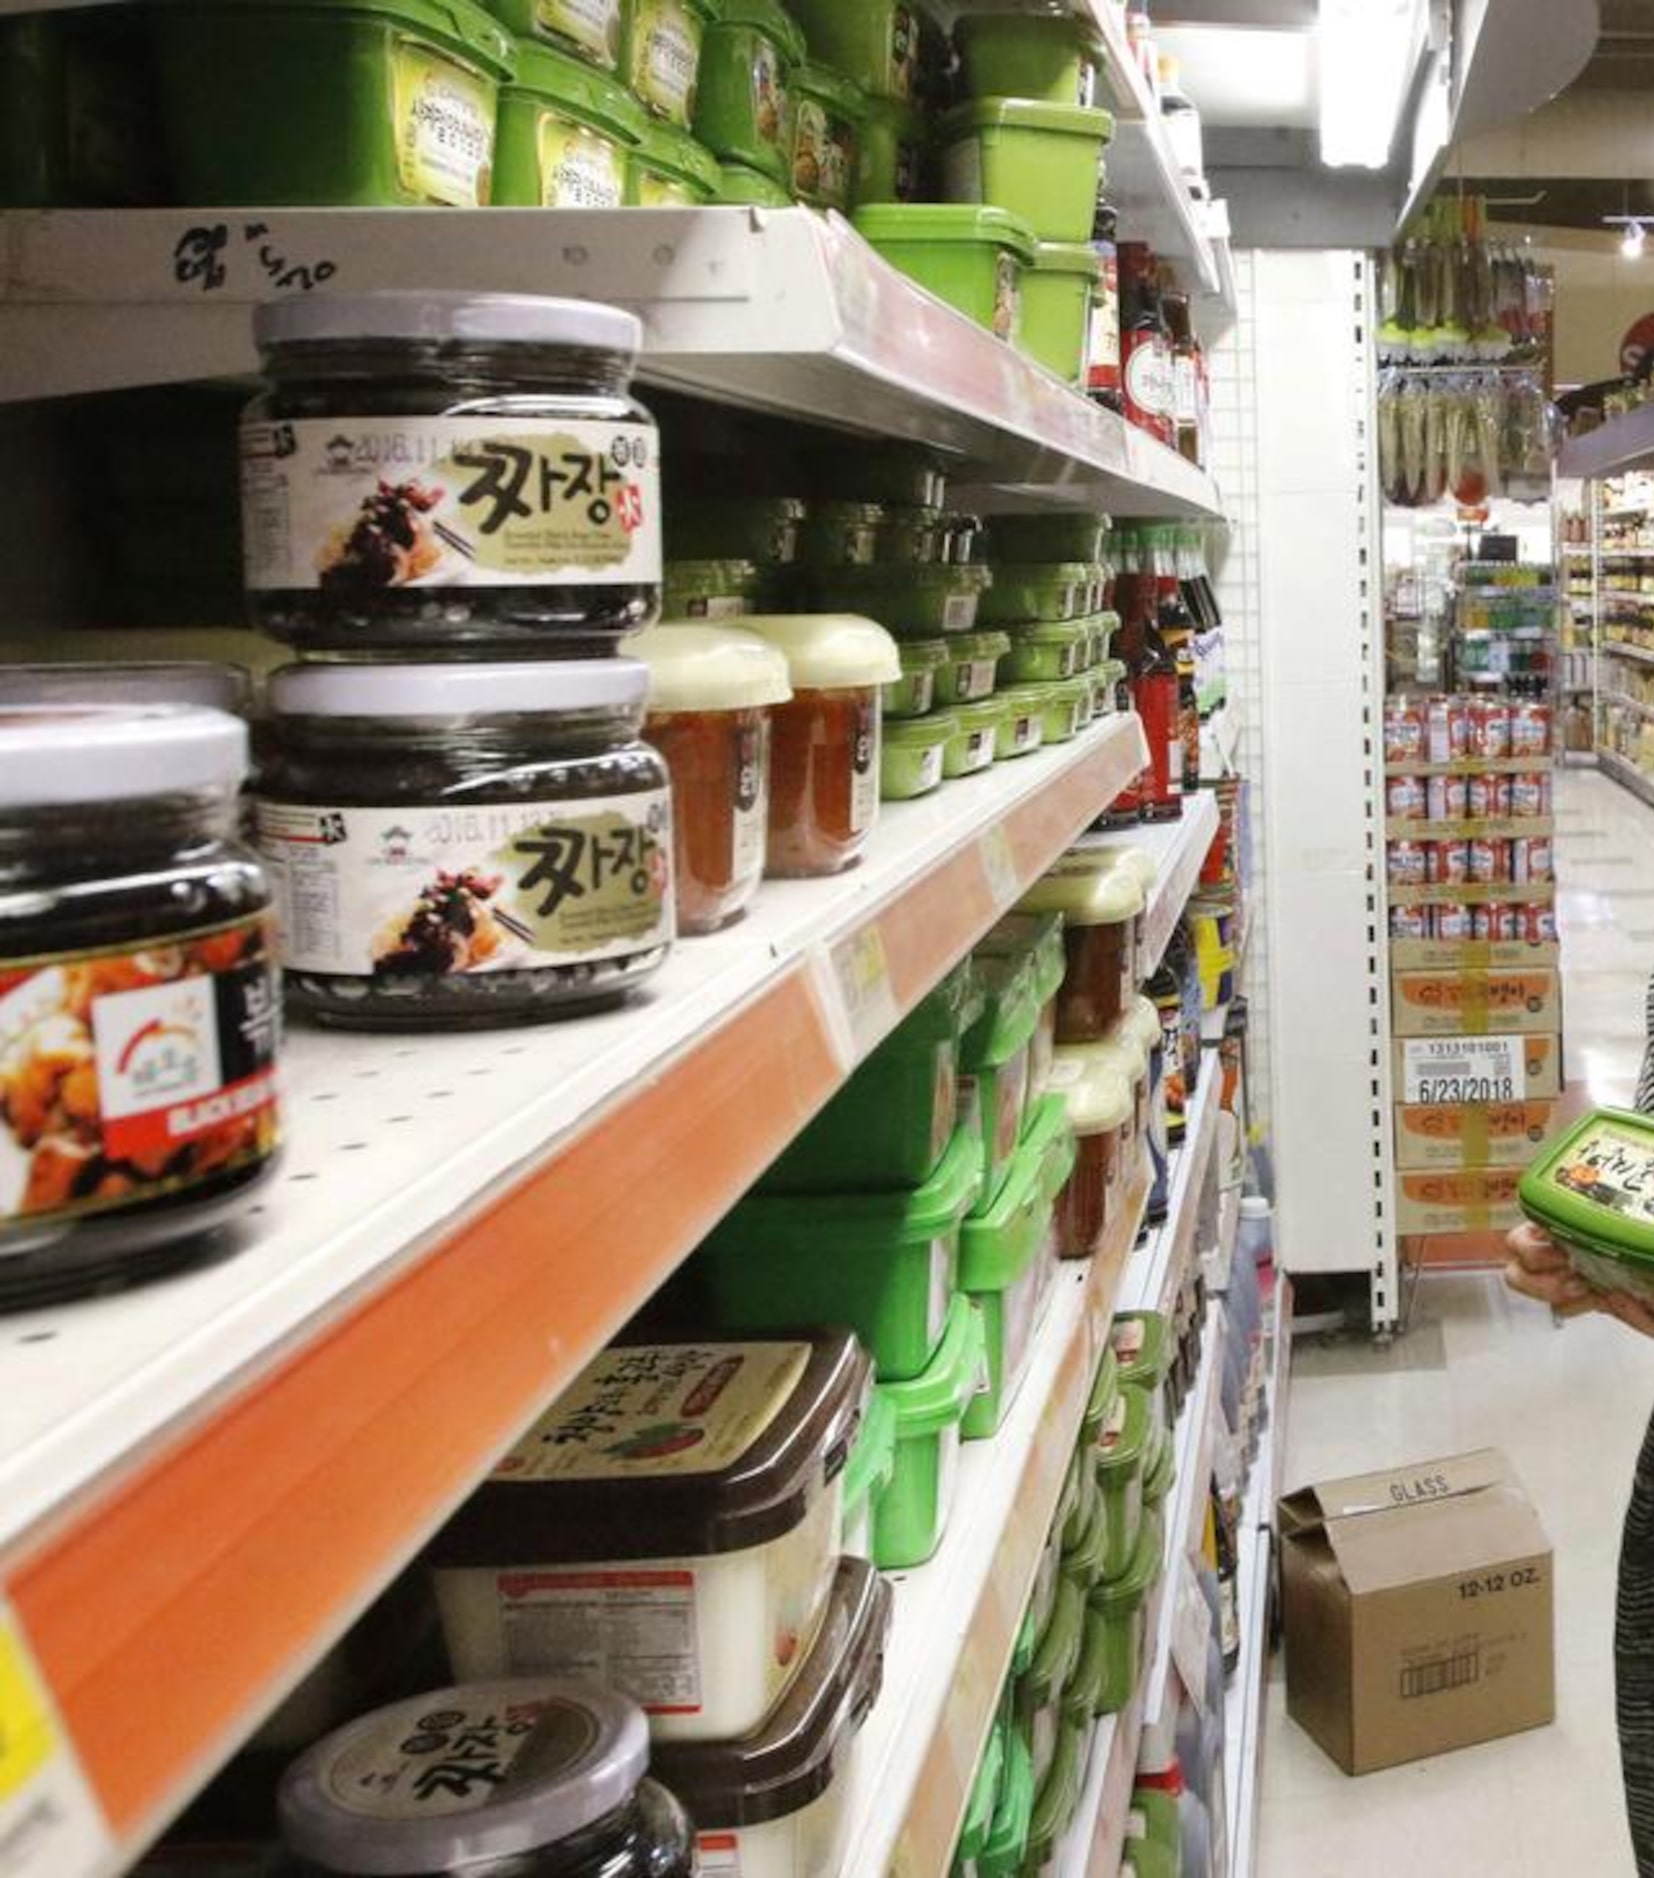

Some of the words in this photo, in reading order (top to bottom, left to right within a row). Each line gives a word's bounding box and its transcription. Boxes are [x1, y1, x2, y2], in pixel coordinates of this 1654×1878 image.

[452, 442, 622, 535] 짜장
[514, 825, 657, 917] 짜장
[1419, 1078, 1514, 1104] 6/23/2018
[1390, 1475, 1449, 1502] GLASS
[1458, 1574, 1506, 1600] 12-12
